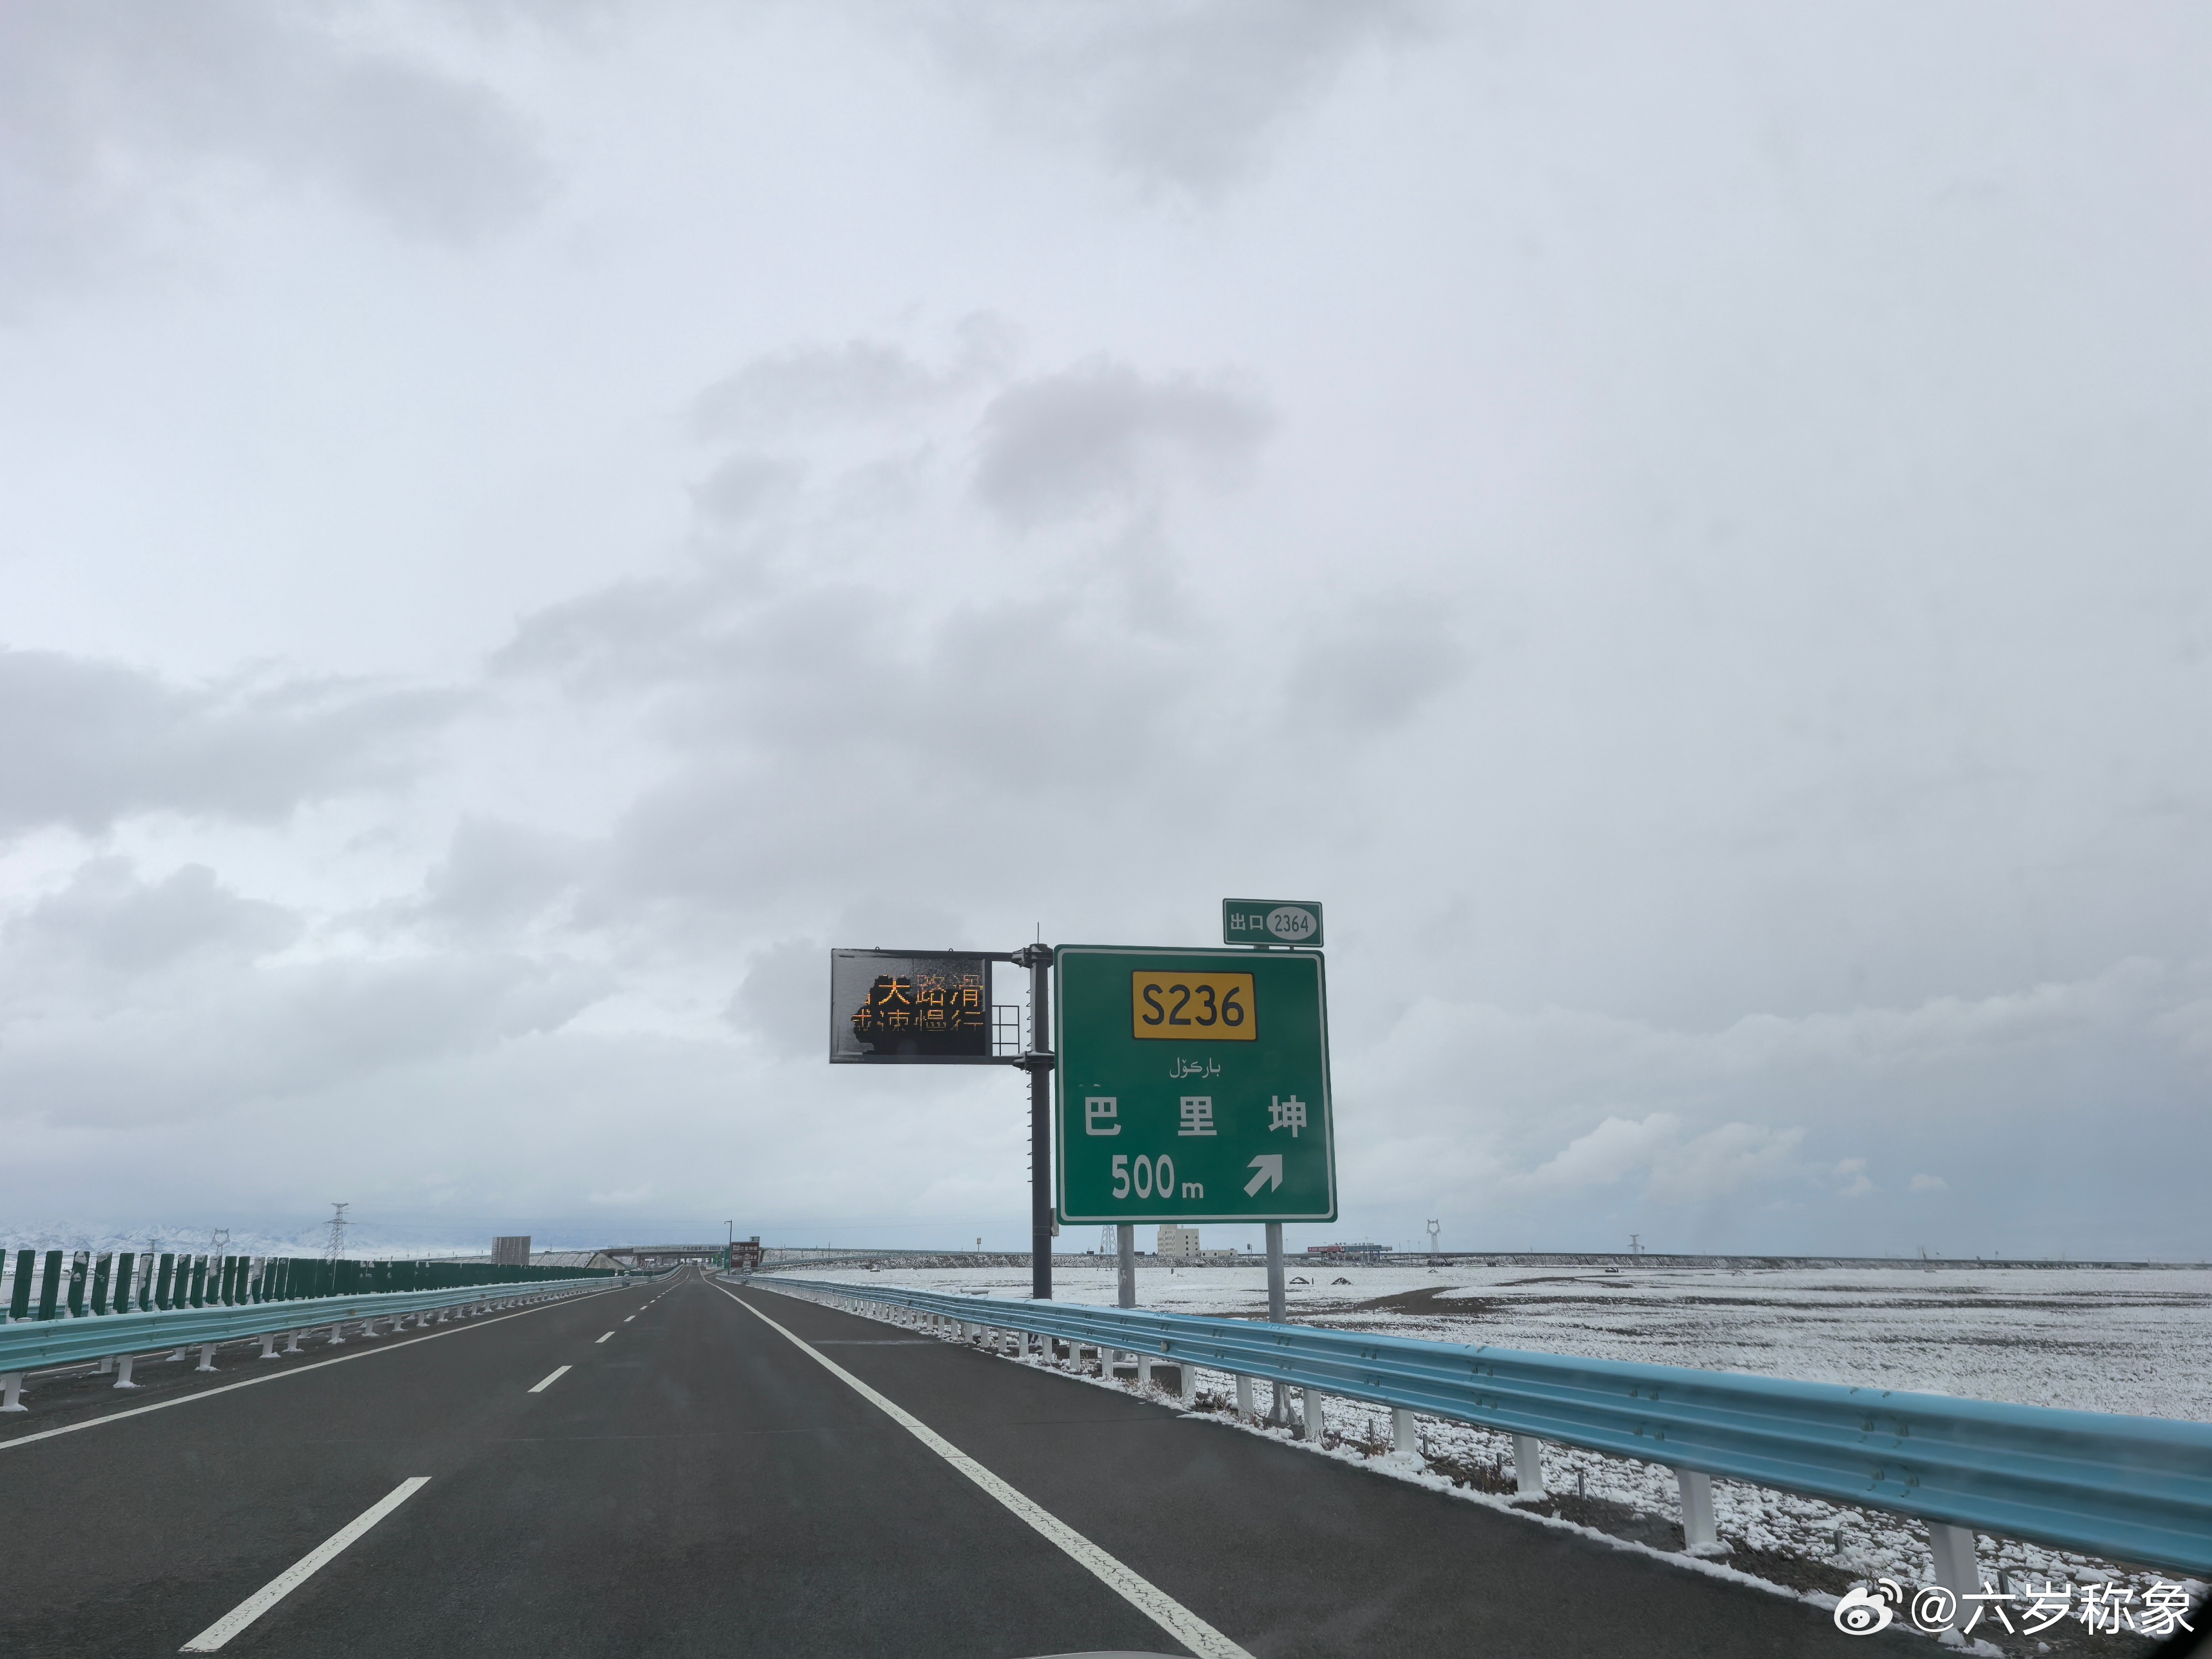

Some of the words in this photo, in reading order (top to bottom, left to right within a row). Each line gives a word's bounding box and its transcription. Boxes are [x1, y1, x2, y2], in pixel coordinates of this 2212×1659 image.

[1231, 913, 1263, 930] 出口
[1274, 914, 1309, 932] 2364
[864, 974, 983, 1006] 天路滑
[1142, 984, 1244, 1026] S236
[1085, 1095, 1307, 1137] 巴里坤
